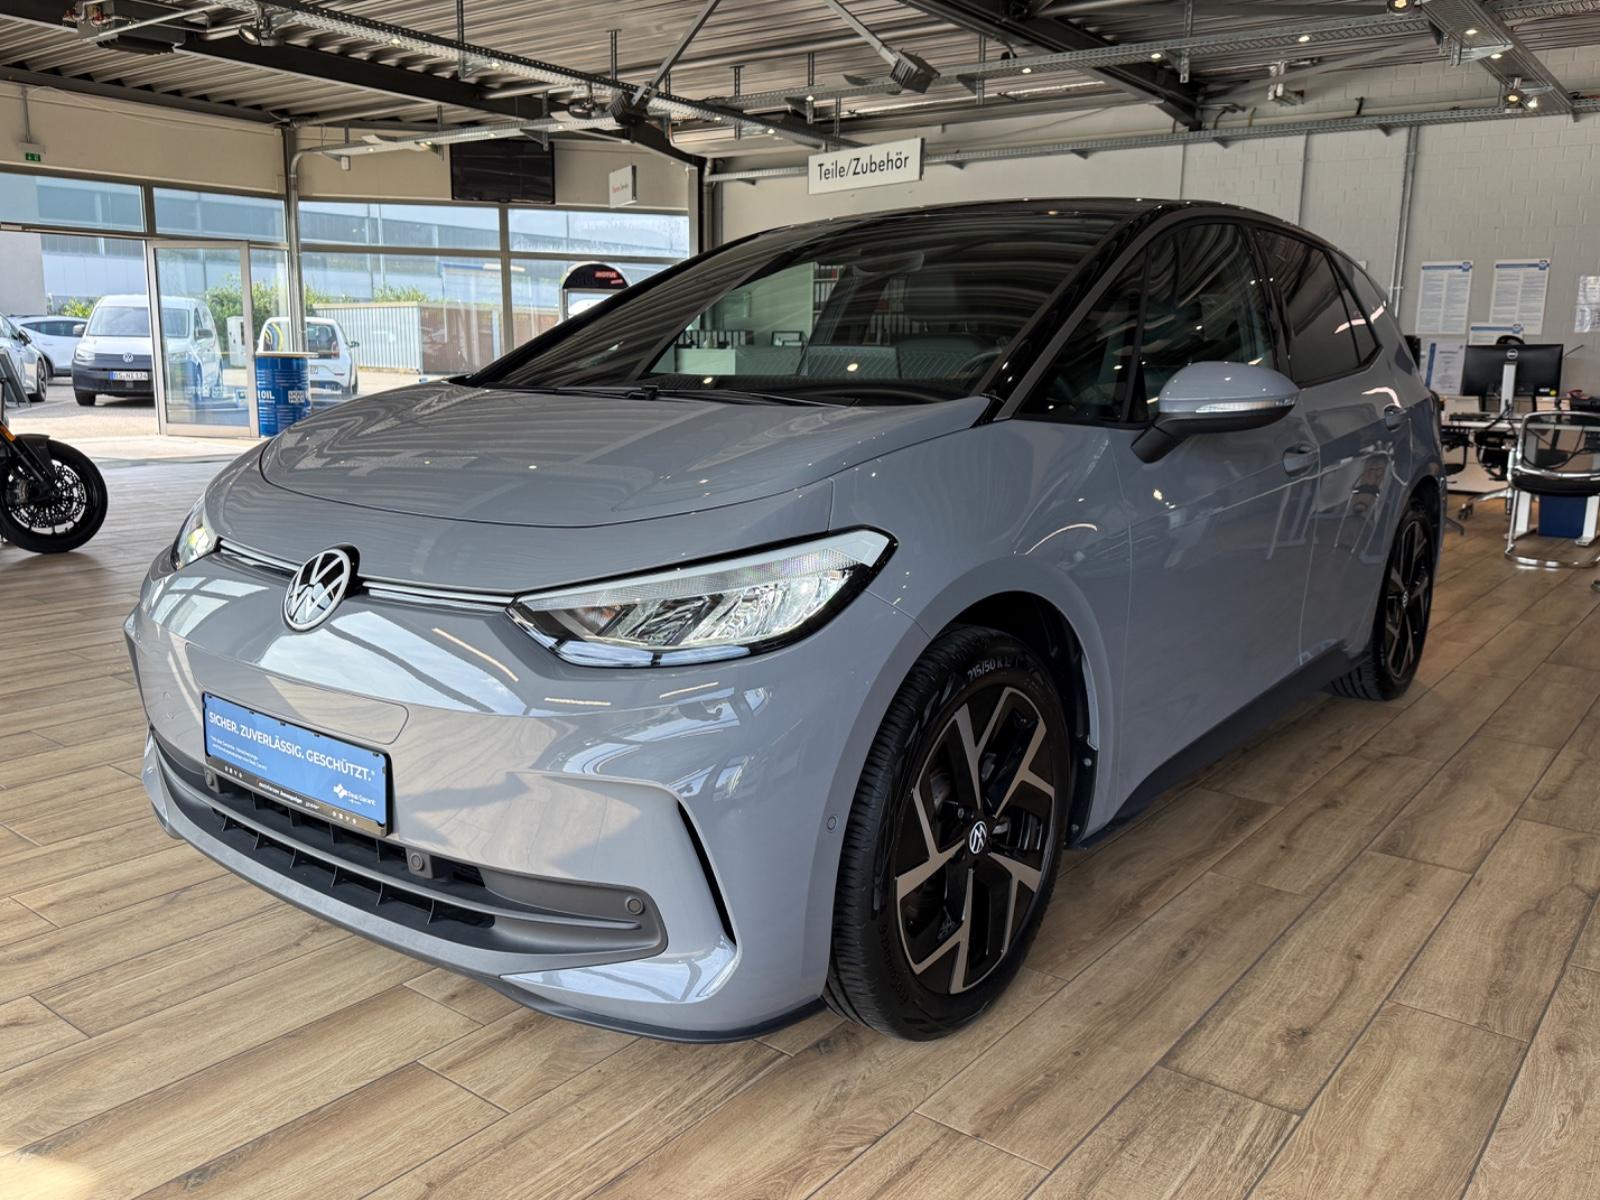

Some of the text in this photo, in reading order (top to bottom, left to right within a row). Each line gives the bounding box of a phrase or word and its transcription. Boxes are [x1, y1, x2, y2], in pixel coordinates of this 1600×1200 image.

[817, 152, 910, 181] Teile/Zubehör
[208, 711, 239, 734] SICHER.
[240, 724, 305, 760] ZUVERLÄSSIG.
